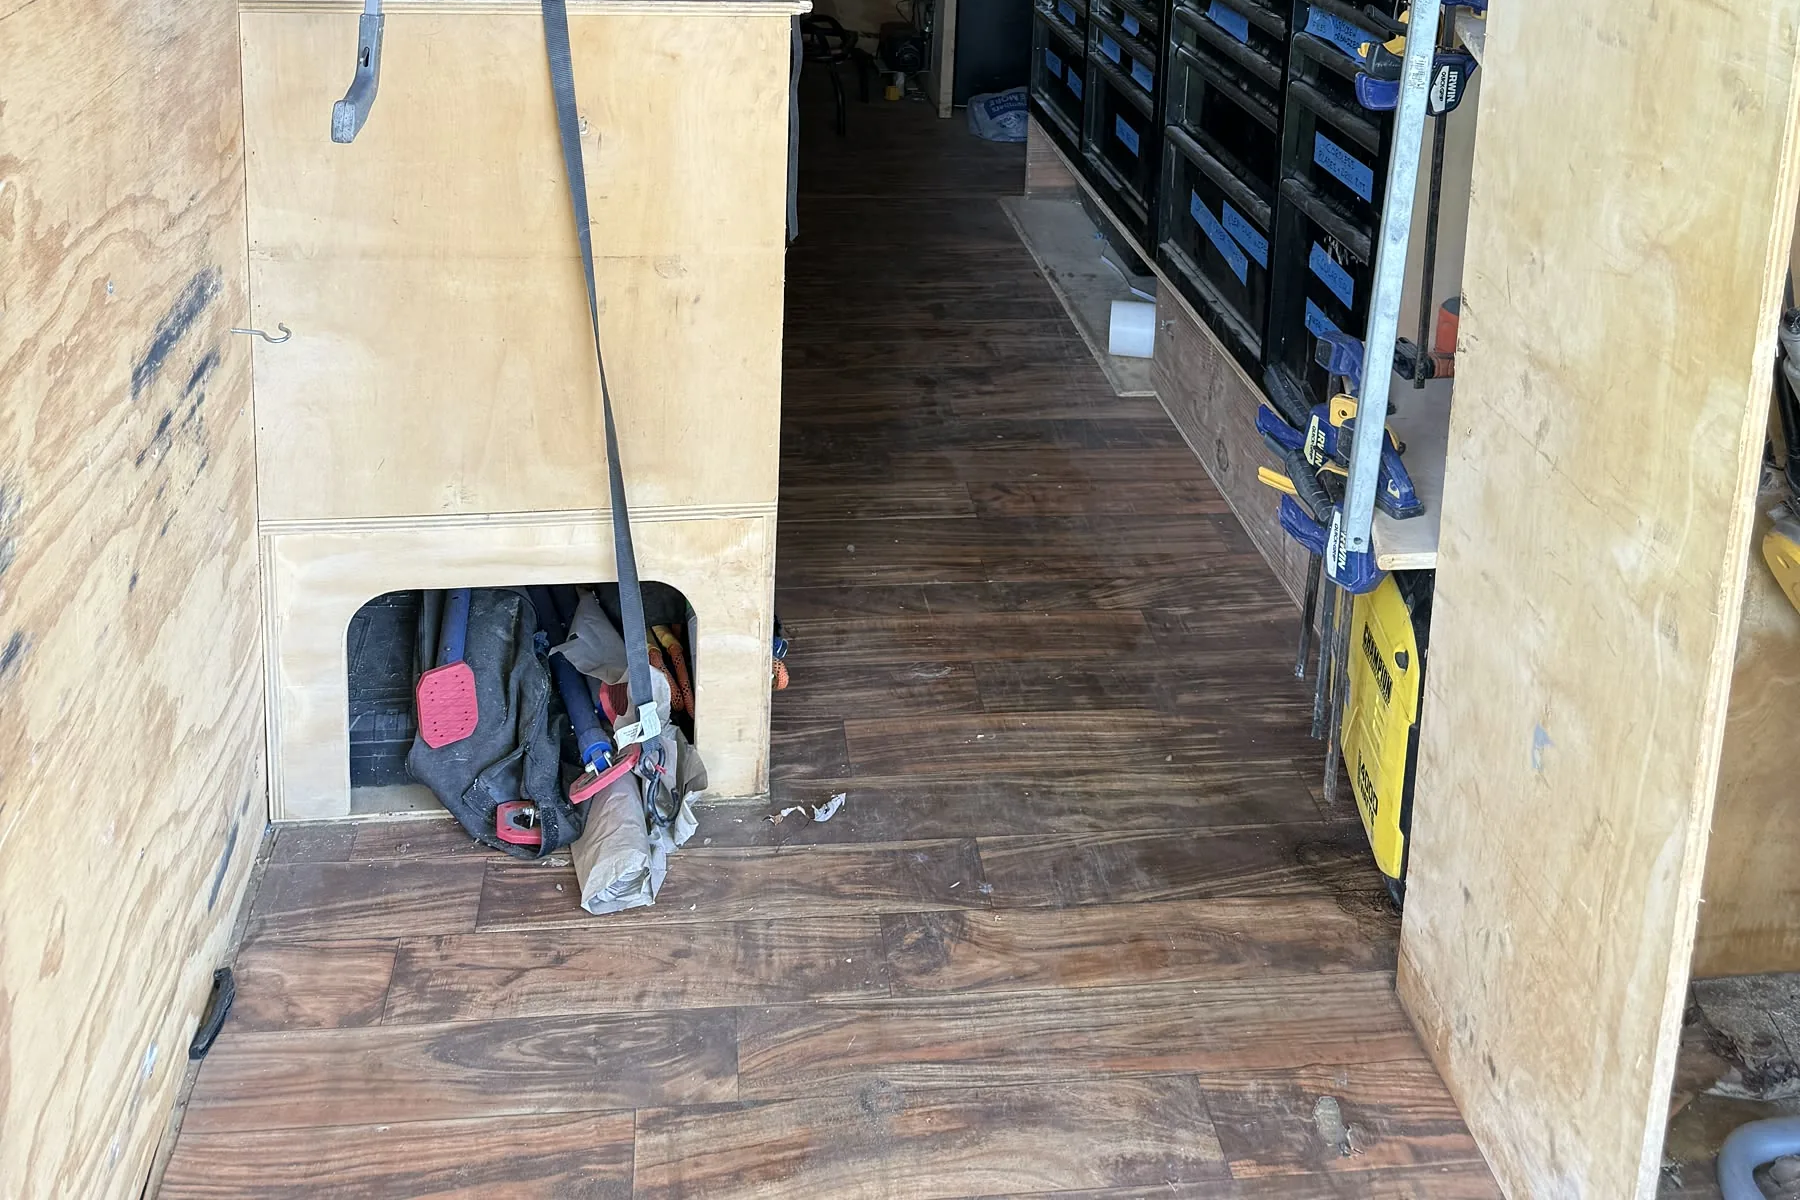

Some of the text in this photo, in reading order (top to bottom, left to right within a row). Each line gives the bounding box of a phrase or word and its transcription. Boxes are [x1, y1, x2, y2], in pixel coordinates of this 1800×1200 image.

[1446, 71, 1458, 103] IRWIN
[1337, 531, 1347, 571] RWIN
[1363, 621, 1393, 701] CHAMPION
[1361, 762, 1379, 816] 4000
